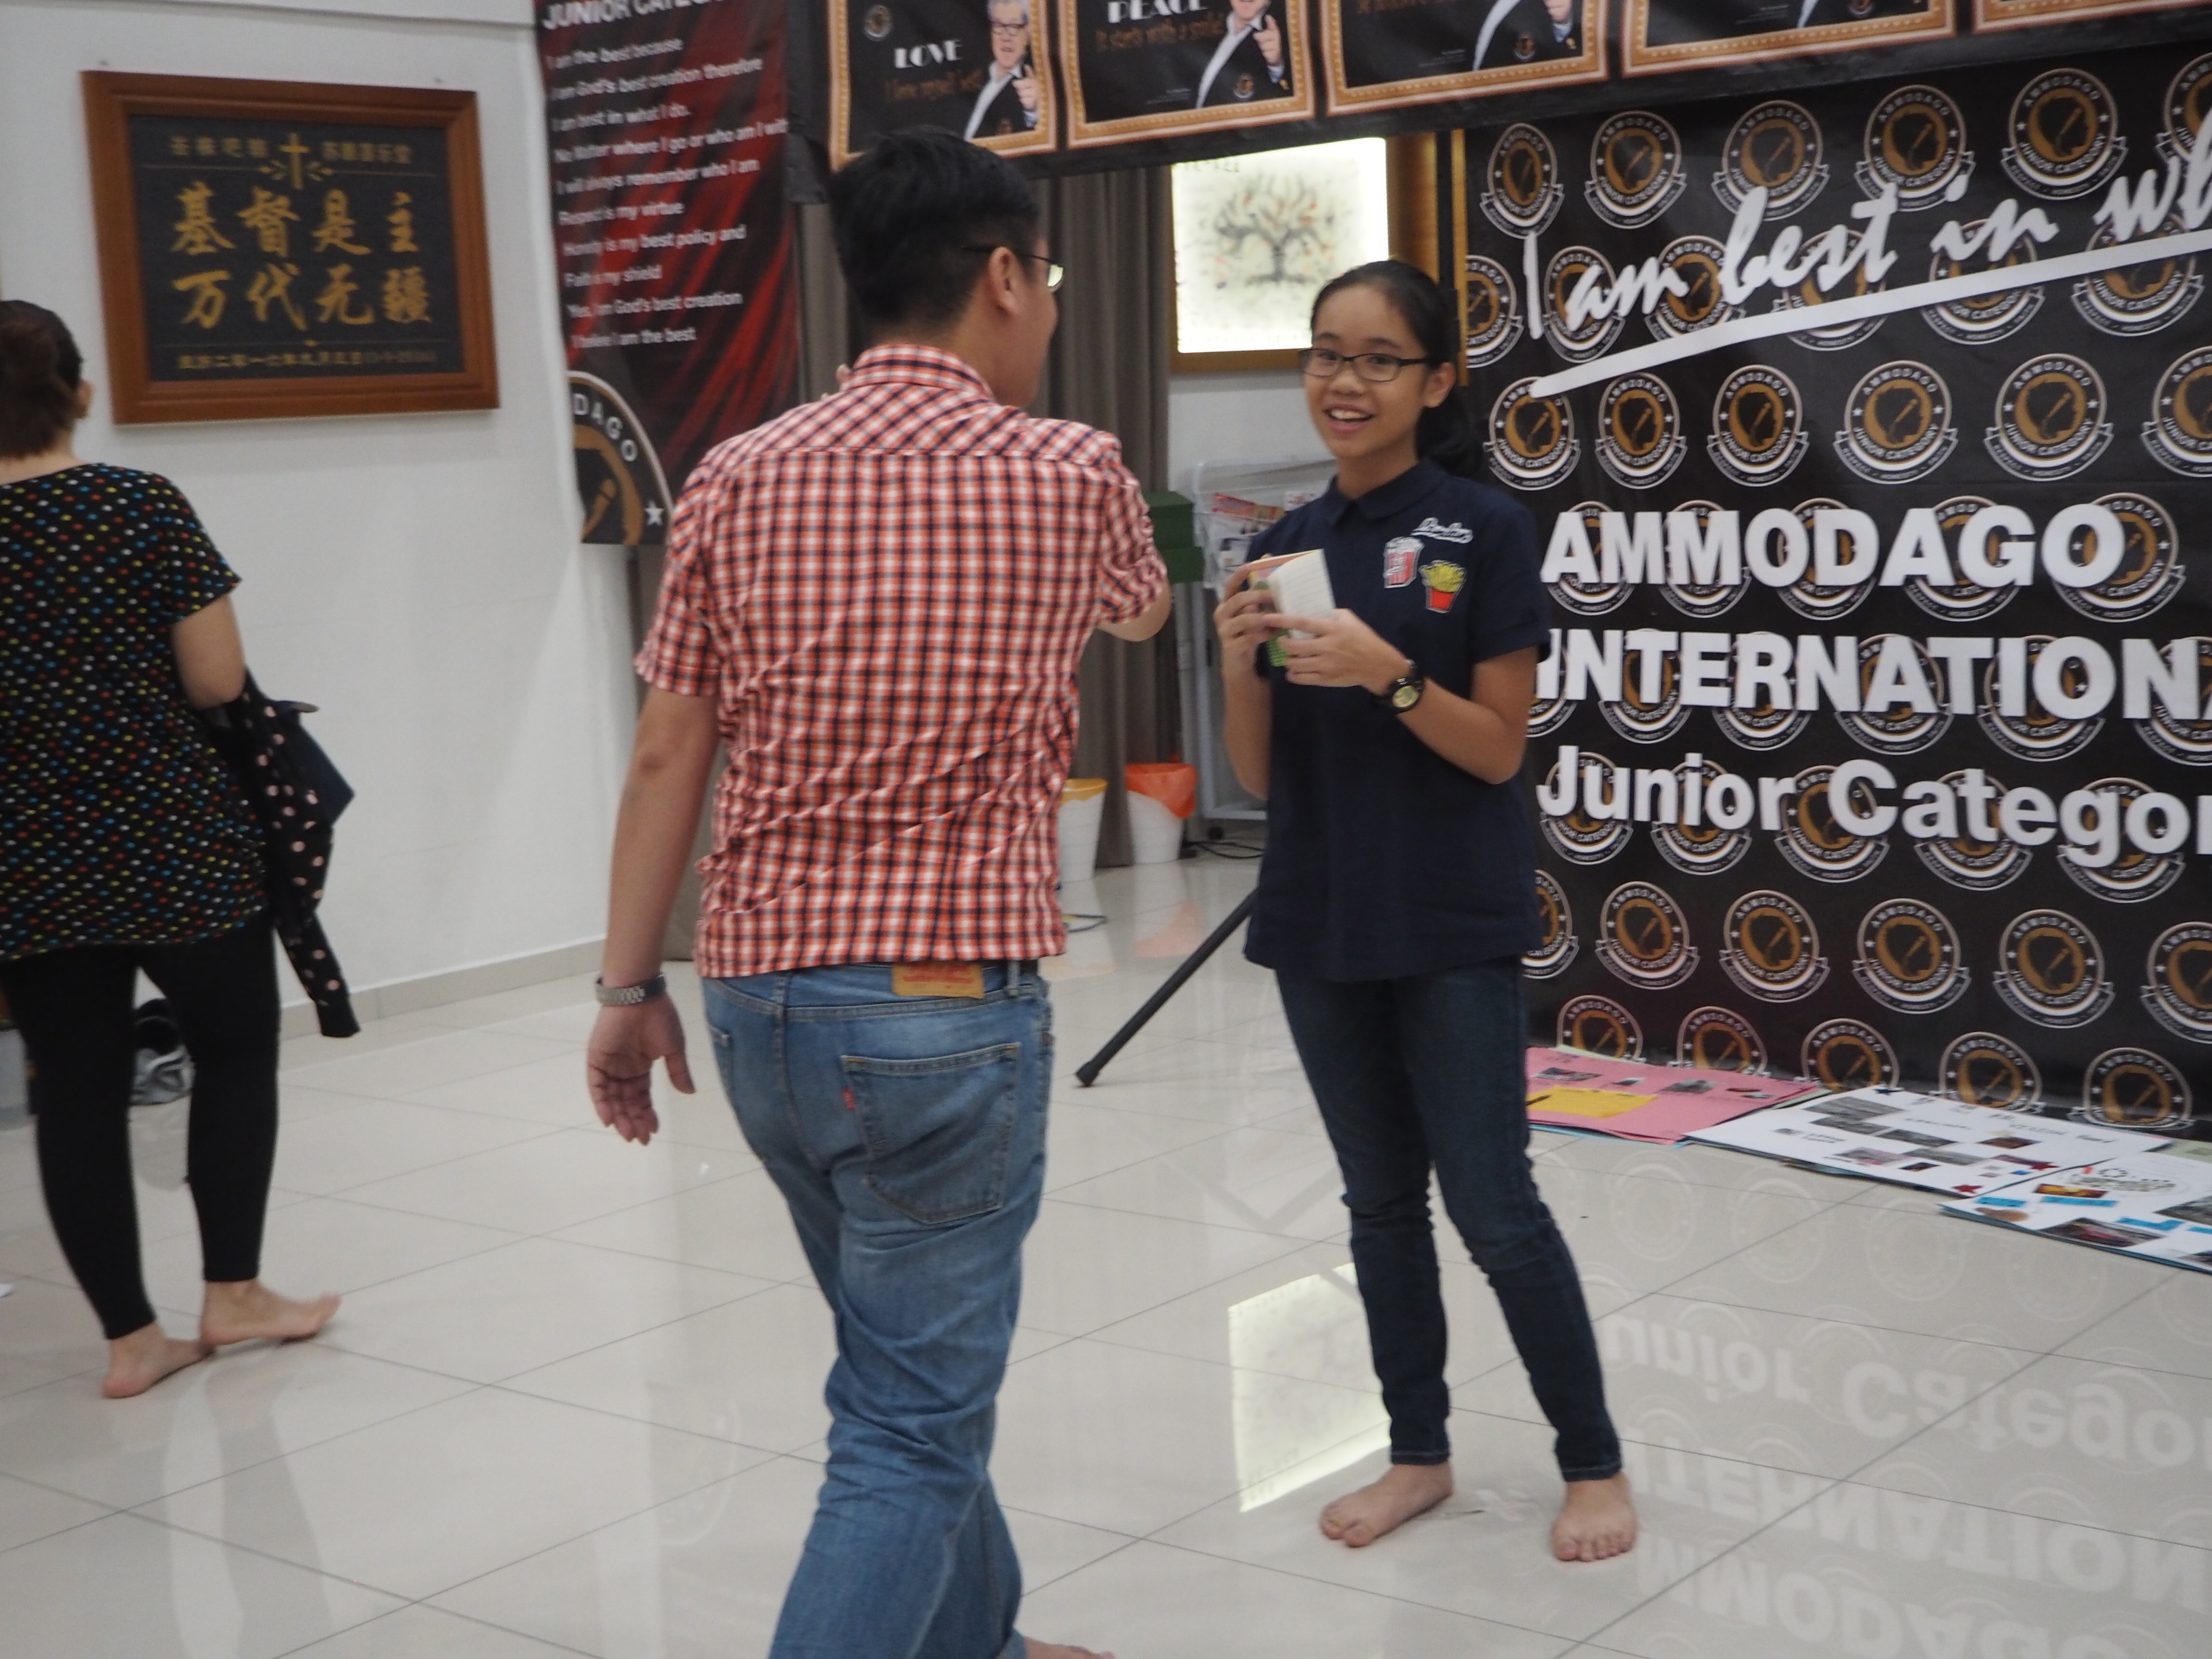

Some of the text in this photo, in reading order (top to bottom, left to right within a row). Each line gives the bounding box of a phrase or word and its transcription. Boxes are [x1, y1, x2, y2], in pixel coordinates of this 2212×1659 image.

[894, 38, 963, 69] LOVE
[171, 180, 420, 258] 基督是主
[639, 232, 675, 249] best
[675, 230, 716, 249] policy
[1563, 256, 1690, 332] am
[1717, 181, 1899, 306] best
[1928, 173, 2061, 263] in
[572, 392, 638, 462] DAGO
[1539, 503, 2126, 588] AMMODAGO
[1536, 628, 2212, 721] INTERNATION
[1536, 745, 1797, 831] Junior
